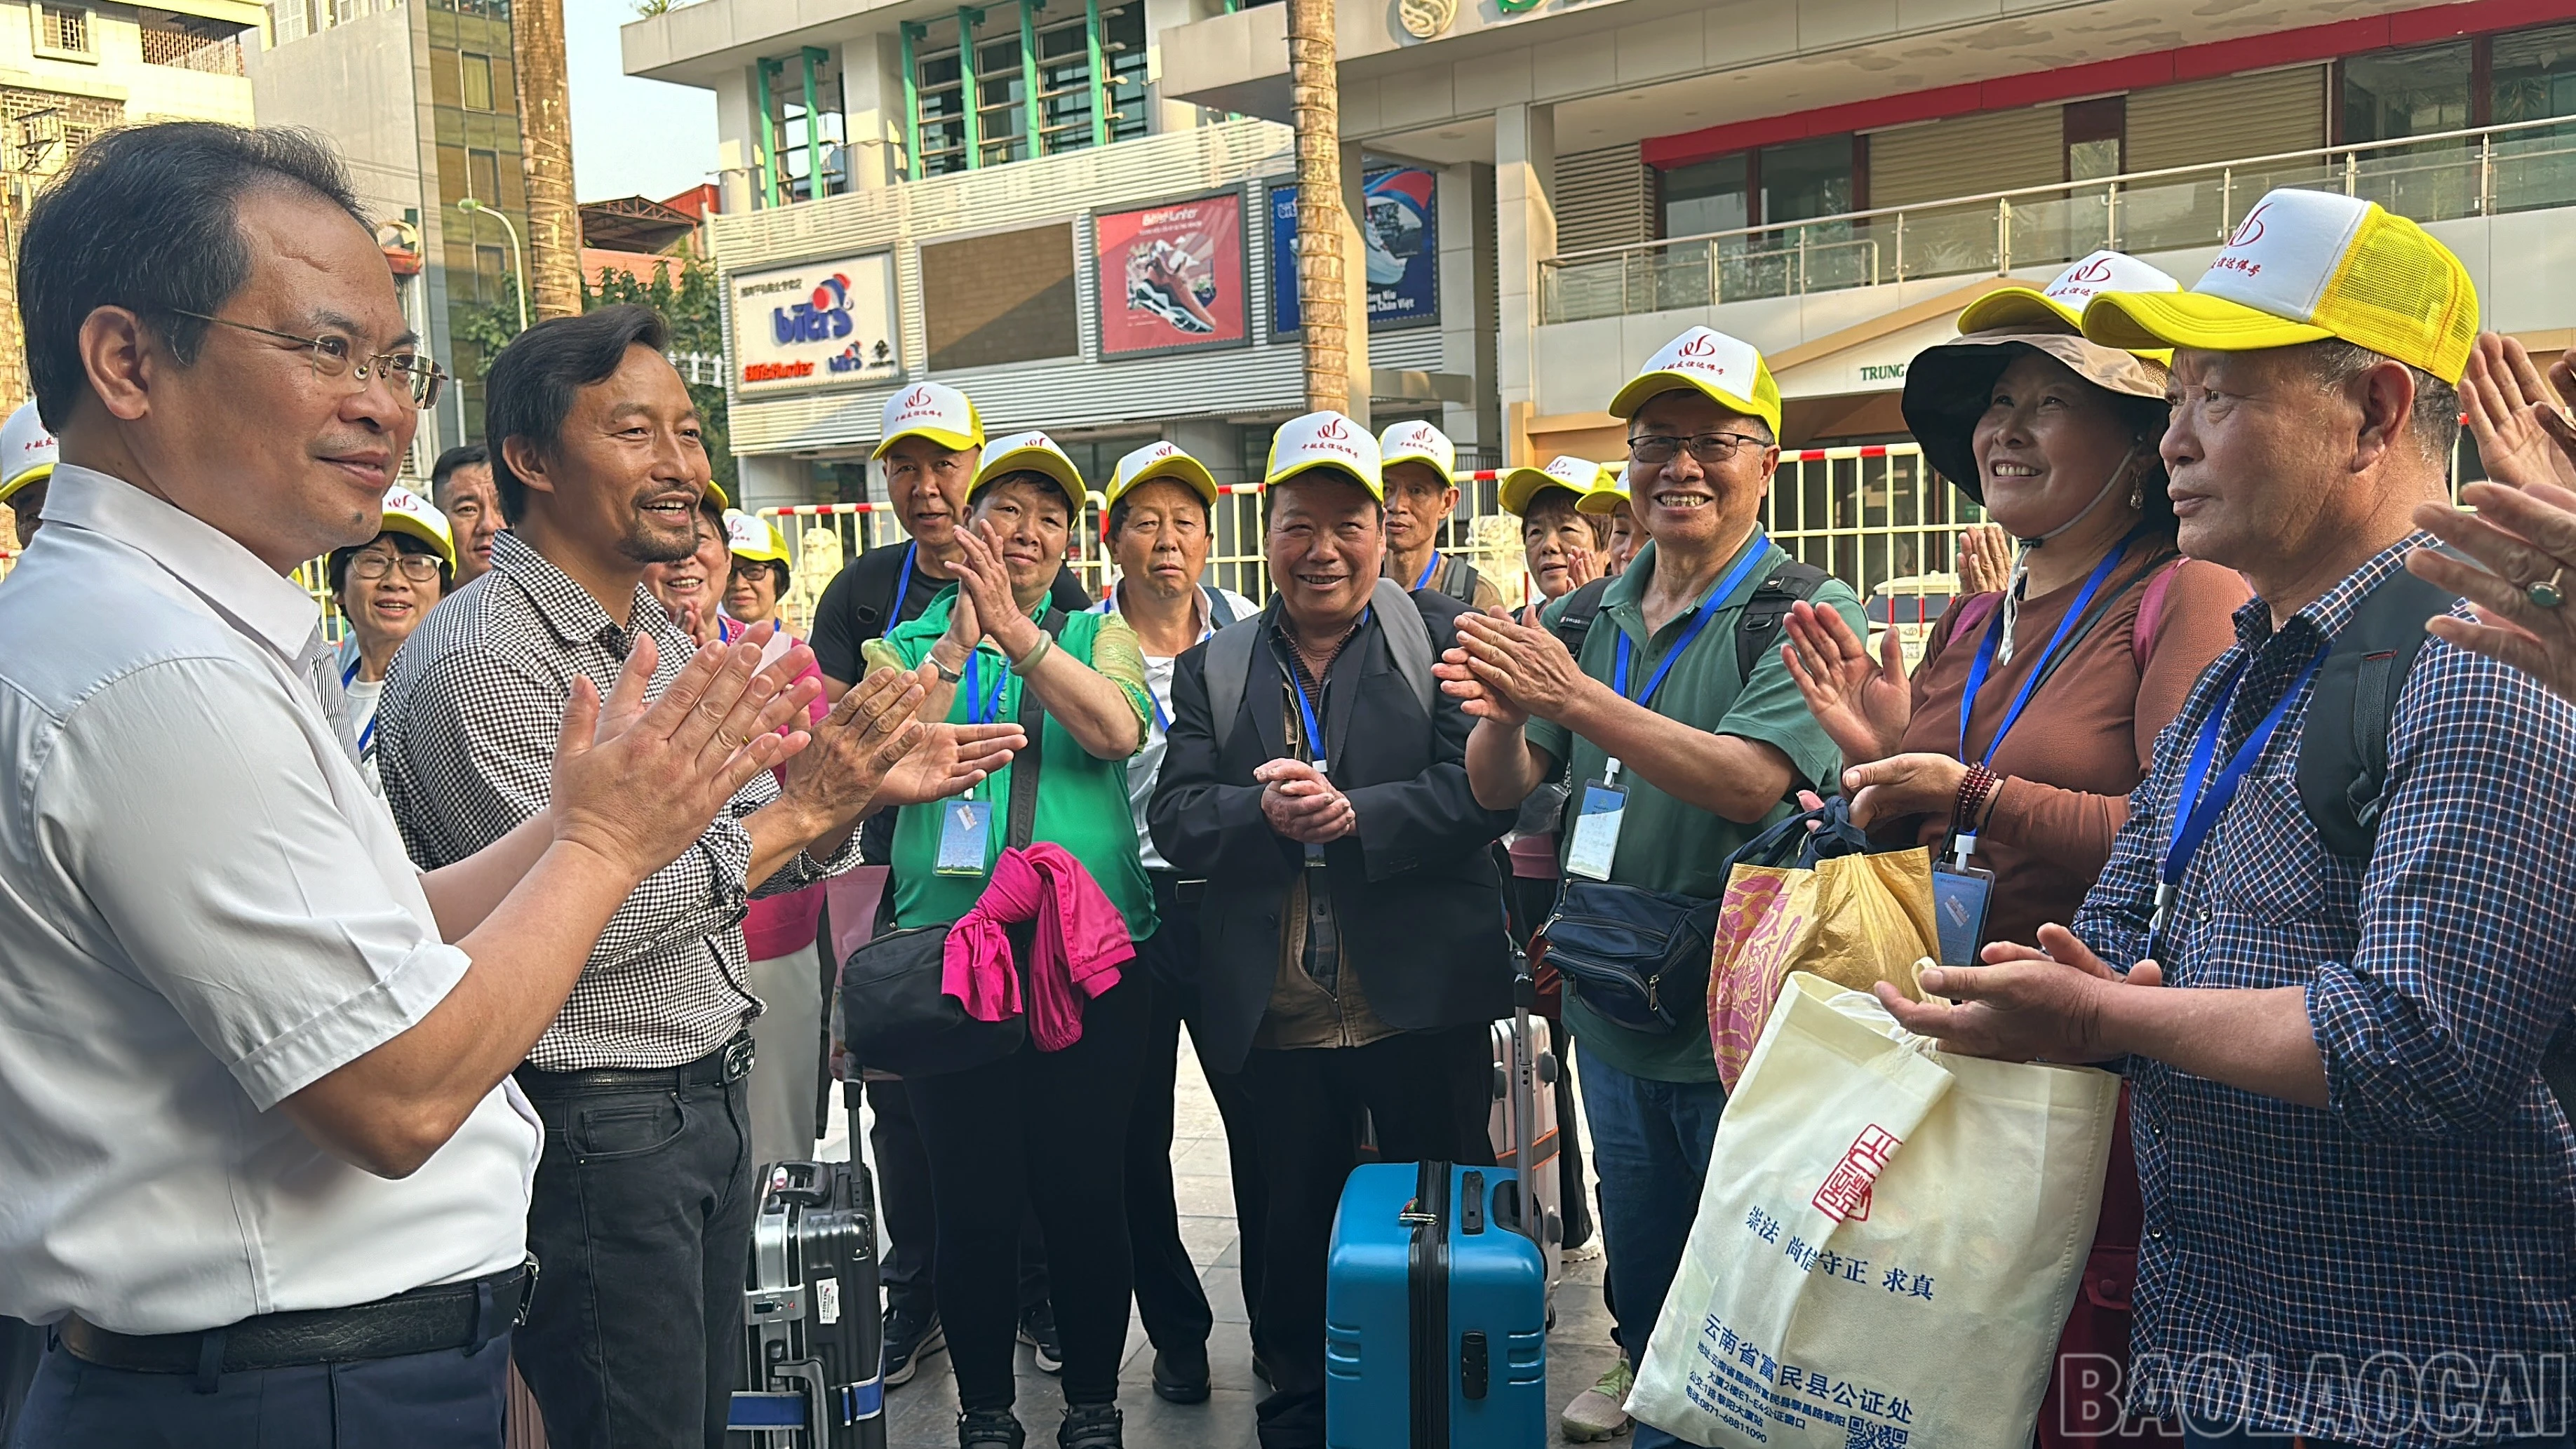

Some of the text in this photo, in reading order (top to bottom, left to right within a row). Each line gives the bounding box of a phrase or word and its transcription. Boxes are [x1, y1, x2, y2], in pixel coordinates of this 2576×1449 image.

[1860, 364, 1905, 381] TRUNG
[1745, 1205, 1780, 1244] 崇法
[1882, 1267, 1934, 1300] 求真
[1704, 1314, 1913, 1424] 云南省富民县公证处
